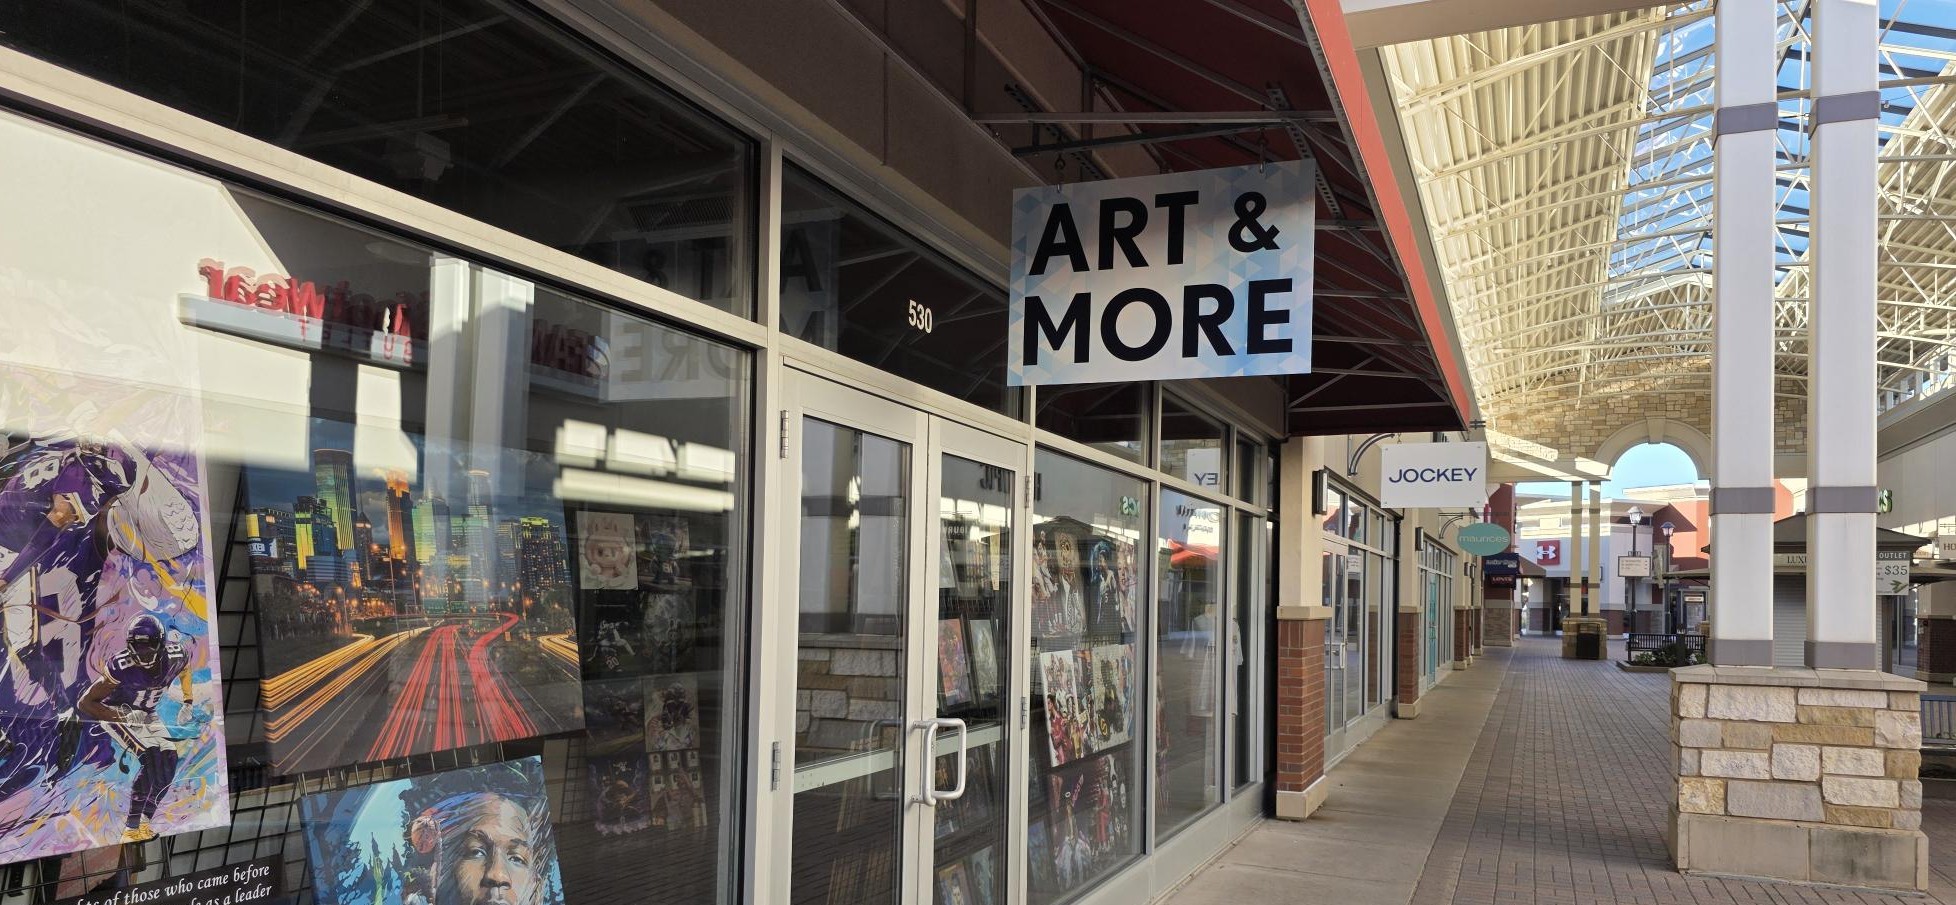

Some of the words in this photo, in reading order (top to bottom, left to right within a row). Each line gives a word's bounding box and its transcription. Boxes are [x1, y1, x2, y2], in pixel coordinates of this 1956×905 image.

[1029, 190, 1199, 276] ART
[1228, 191, 1280, 253] &
[908, 299, 933, 334] 530
[1023, 278, 1293, 366] MORE
[1388, 467, 1478, 483] JOCKEY
[1459, 535, 1509, 543] maurices
[1884, 565, 1908, 576] $35
[124, 887, 160, 905] those
[164, 878, 193, 897] who
[197, 874, 229, 890] came
[233, 864, 270, 885] before
[223, 895, 231, 905] a
[235, 883, 272, 903] leader
